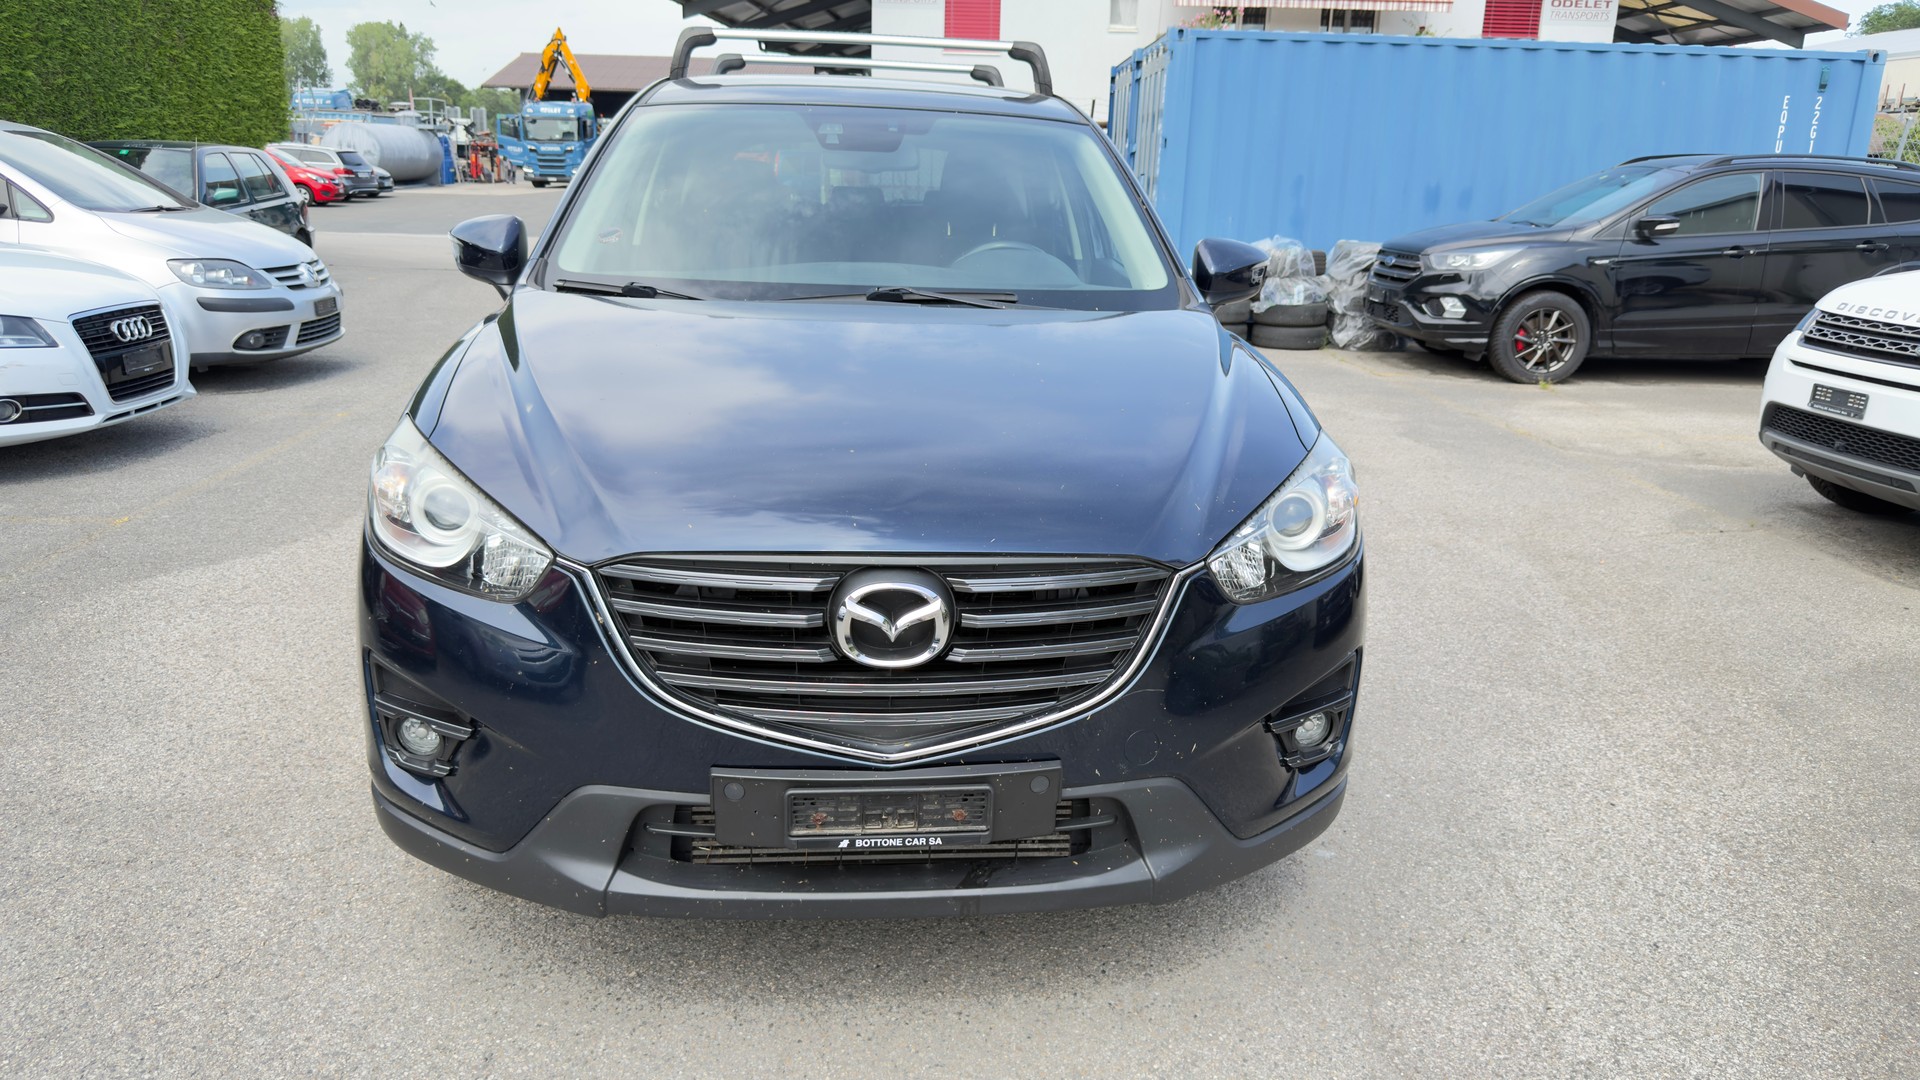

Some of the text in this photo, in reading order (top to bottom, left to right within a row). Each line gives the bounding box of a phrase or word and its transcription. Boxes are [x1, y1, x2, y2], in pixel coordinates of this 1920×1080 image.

[1551, 0, 1612, 9] ODELET
[1550, 10, 1610, 20] TRANSPORTS
[1775, 95, 1790, 154] EQPU
[1809, 96, 1823, 154] 22G1
[1836, 302, 1920, 324] DISCOV
[855, 837, 943, 847] BOTTONE CAR SA
